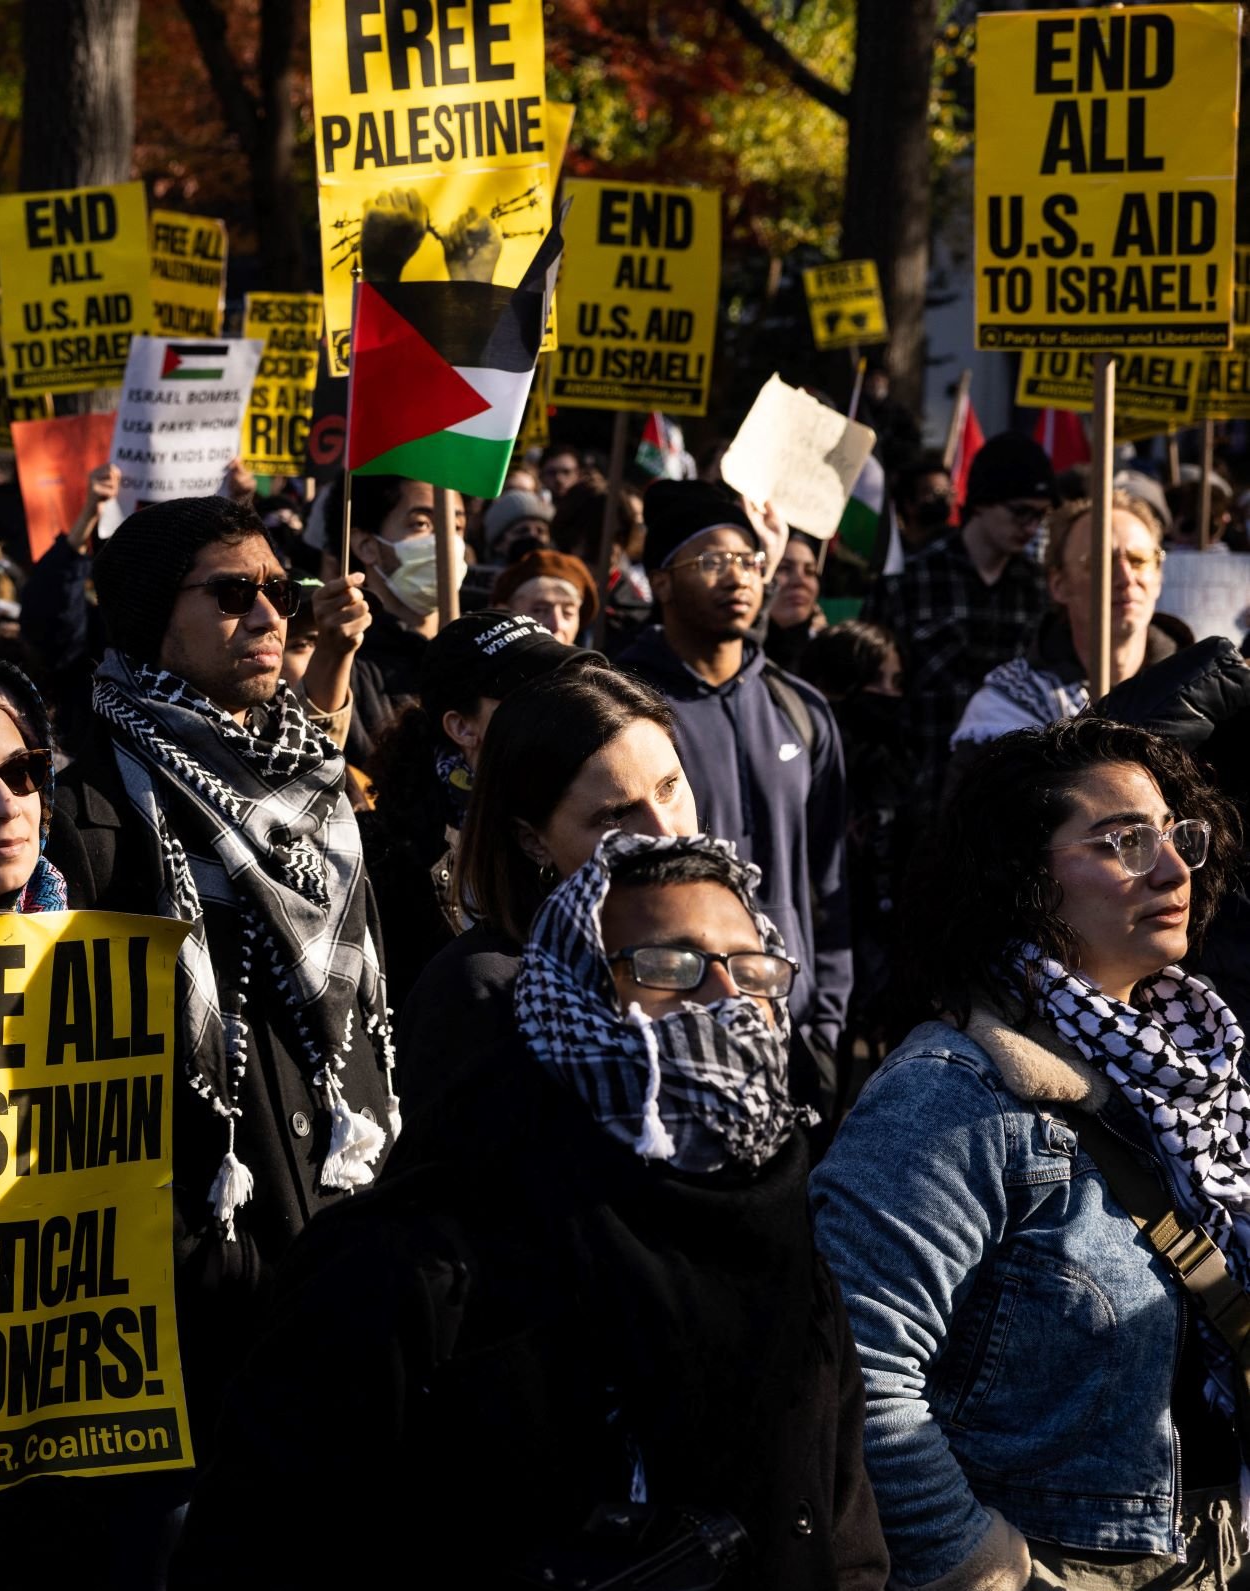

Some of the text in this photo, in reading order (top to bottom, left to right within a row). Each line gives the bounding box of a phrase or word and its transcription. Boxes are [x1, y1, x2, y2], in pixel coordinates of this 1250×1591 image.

[345, 0, 515, 94] FREE
[1034, 13, 1175, 95] END
[321, 96, 544, 172] PALESTINE
[1039, 97, 1164, 175] ALL
[25, 191, 117, 250] END
[597, 188, 694, 251] END
[987, 190, 1218, 259] U.S. AID
[193, 226, 223, 261] ALL
[49, 250, 105, 286] ALL
[614, 255, 672, 292] ALL
[983, 266, 1032, 314] TO
[1045, 264, 1218, 314] ISRAEL!
[23, 293, 132, 333] U.S. AID
[577, 303, 638, 340] U.S.
[644, 307, 695, 344] AID
[12, 330, 149, 369] TO ISRAE
[1004, 326, 1227, 346] Party for Socialism and Liberation
[558, 344, 705, 384] TO ISRAEL!
[127, 388, 241, 405] ISRAEL BOMBS
[122, 418, 154, 434] USA
[117, 448, 168, 465] MANY
[121, 477, 144, 490] OU
[474, 620, 514, 645] MAKE
[482, 627, 532, 655] WRONG
[46, 936, 165, 1066] ALL
[24, 1424, 170, 1465] Coalition
